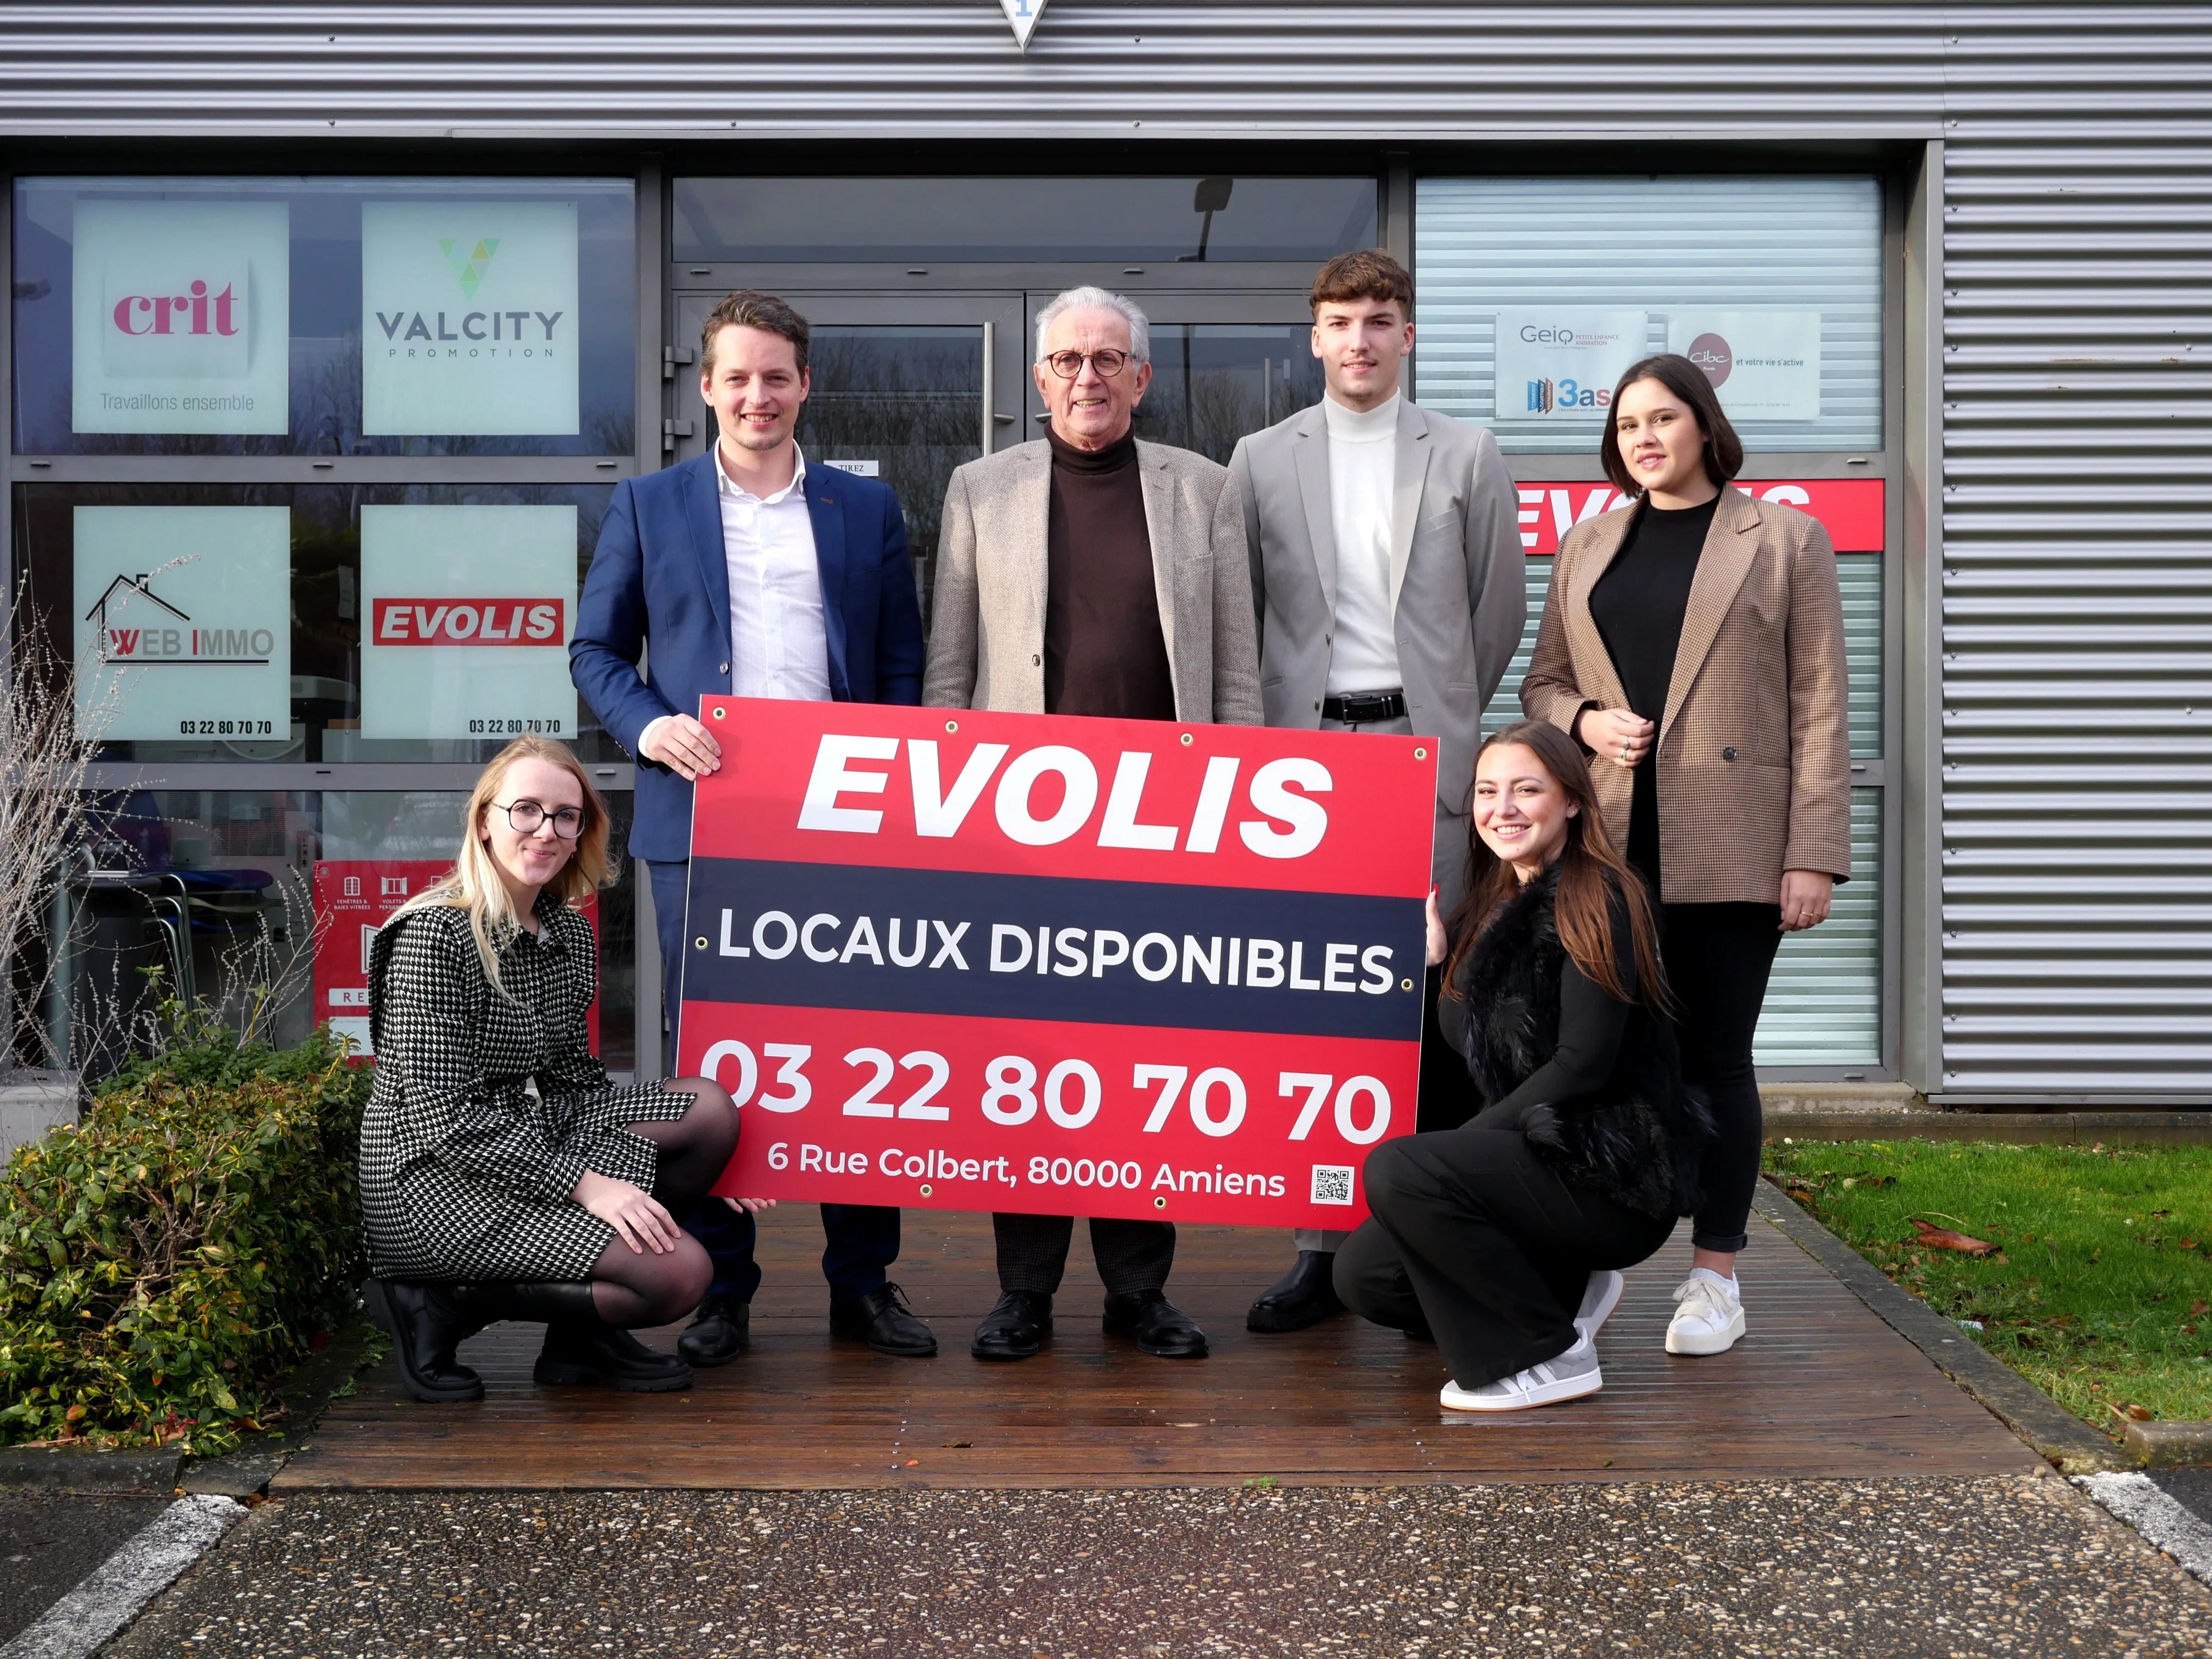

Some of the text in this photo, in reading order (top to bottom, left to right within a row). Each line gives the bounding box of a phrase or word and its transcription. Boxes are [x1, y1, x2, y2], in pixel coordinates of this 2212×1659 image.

[113, 280, 239, 336] crit
[375, 312, 563, 341] VALCITY
[389, 348, 553, 357] PROMOTION
[101, 393, 254, 410] Travaillons ensemble
[1558, 378, 1612, 407] 3as
[380, 605, 556, 639] EVOLIS
[110, 629, 274, 657] WEB IMMO
[180, 720, 272, 735] 03 22 80 70 70
[469, 719, 560, 733] 03 22 80 70 70
[797, 734, 1333, 858] EVOLIS
[719, 908, 1394, 994] LOCAUX DISPONIBLES
[700, 1040, 1391, 1145] 03 22 80 70 70
[768, 1142, 1286, 1196] 6 Rue Colbert, 80000 Amiens
